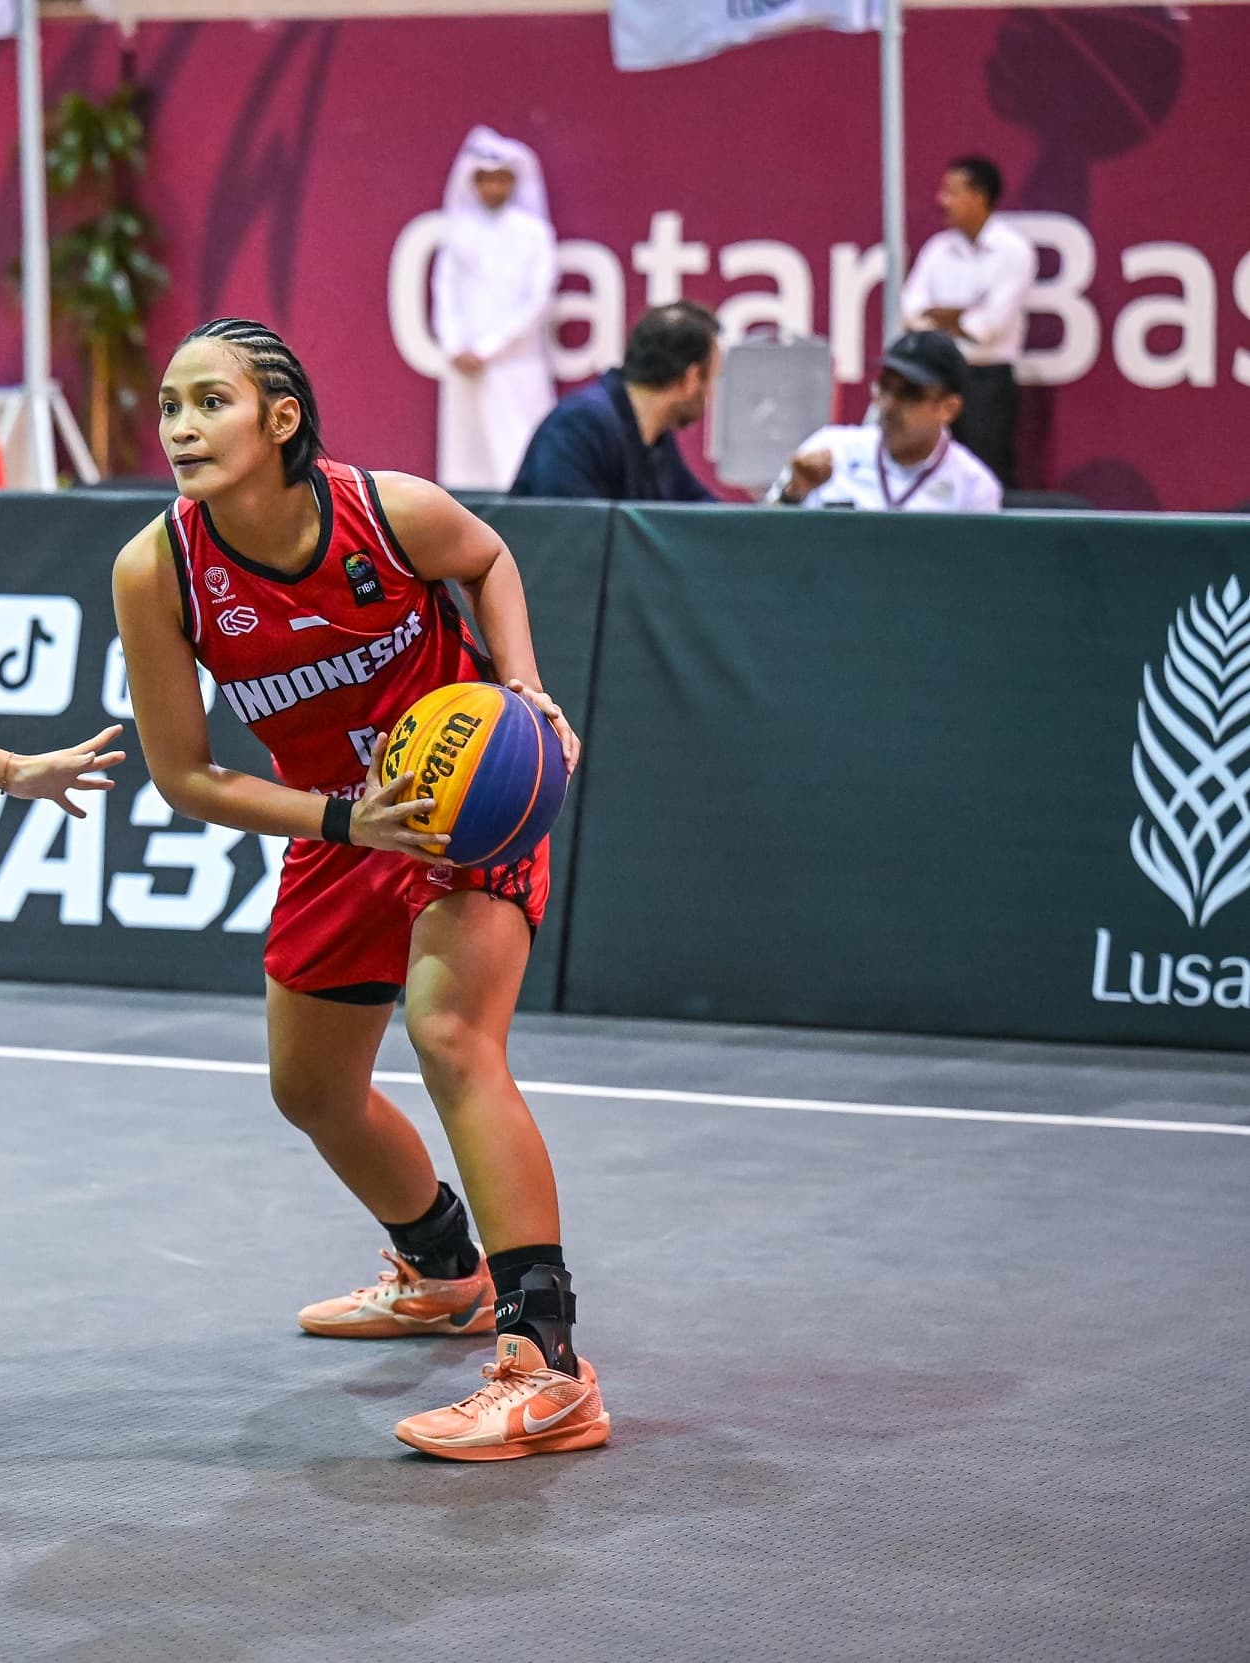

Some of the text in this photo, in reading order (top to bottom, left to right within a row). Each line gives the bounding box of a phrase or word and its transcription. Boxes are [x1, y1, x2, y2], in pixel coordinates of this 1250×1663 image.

[1008, 211, 1250, 389] Ba
[356, 580, 376, 595] FIBA
[219, 610, 423, 724] INDONESIA
[1092, 926, 1250, 1009] Lusa
